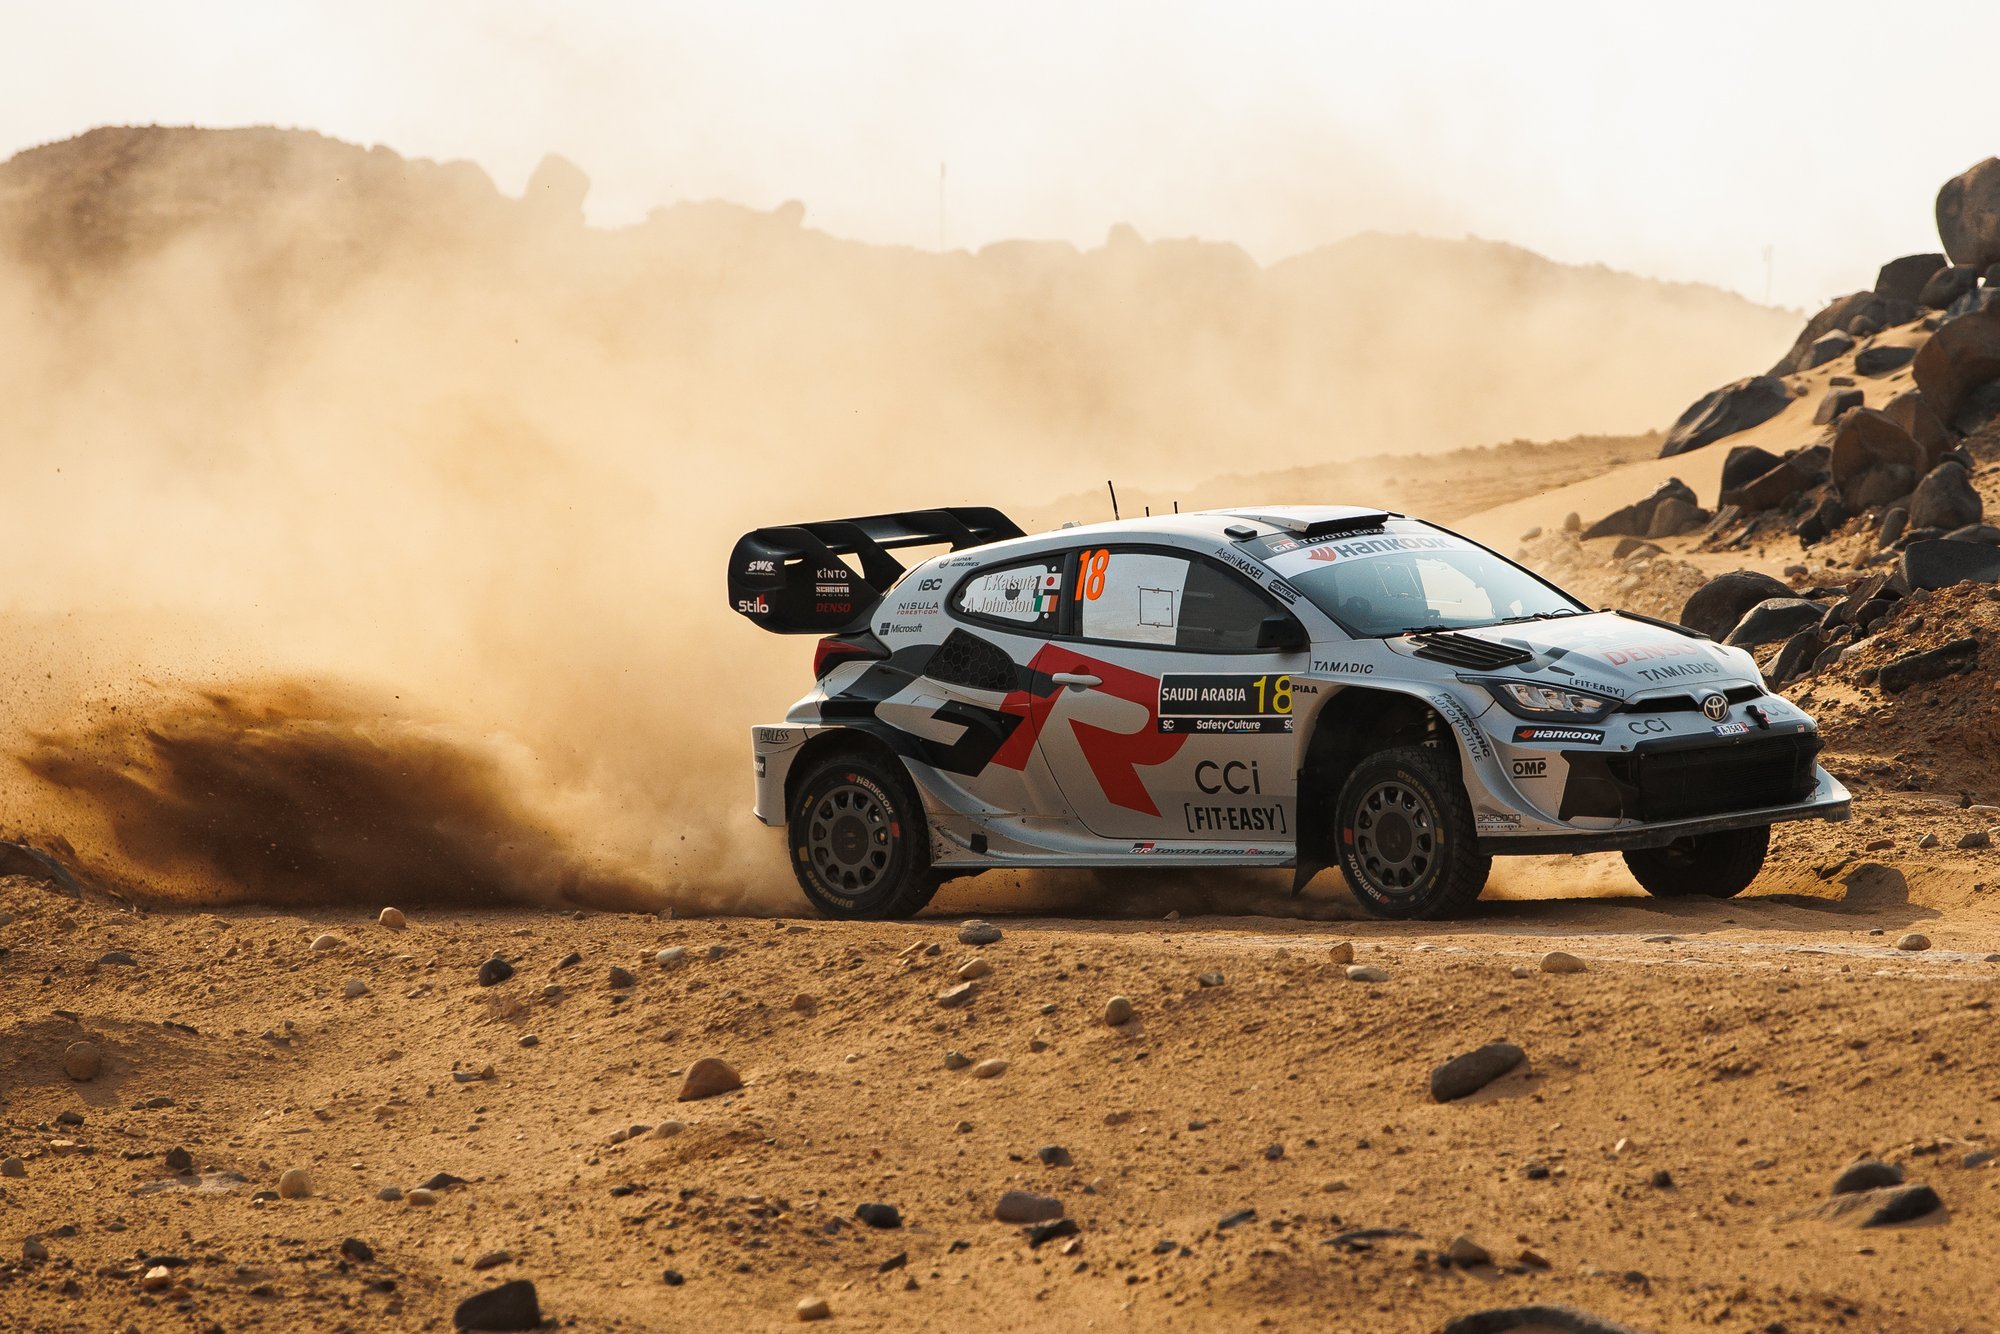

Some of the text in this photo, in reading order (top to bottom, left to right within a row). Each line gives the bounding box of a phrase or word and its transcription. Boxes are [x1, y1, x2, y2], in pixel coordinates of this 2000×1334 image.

[1301, 531, 1349, 545] TOYOTA
[1074, 548, 1110, 601] 18
[1269, 581, 1298, 601] CENTRAL
[738, 597, 769, 613] Stilo
[816, 602, 851, 613] DENSO
[898, 602, 939, 610] NISULA
[890, 623, 923, 633] Microsoft
[1601, 642, 1698, 666] DENSO
[1161, 675, 1293, 714] SAUDI ARABIA 18
[1292, 684, 1318, 694] PIAA
[1427, 695, 1483, 763] AUTOMOTIVE
[1438, 692, 1491, 759] Panasonic
[760, 728, 790, 744] ENDLESS
[1513, 761, 1547, 775] OMP
